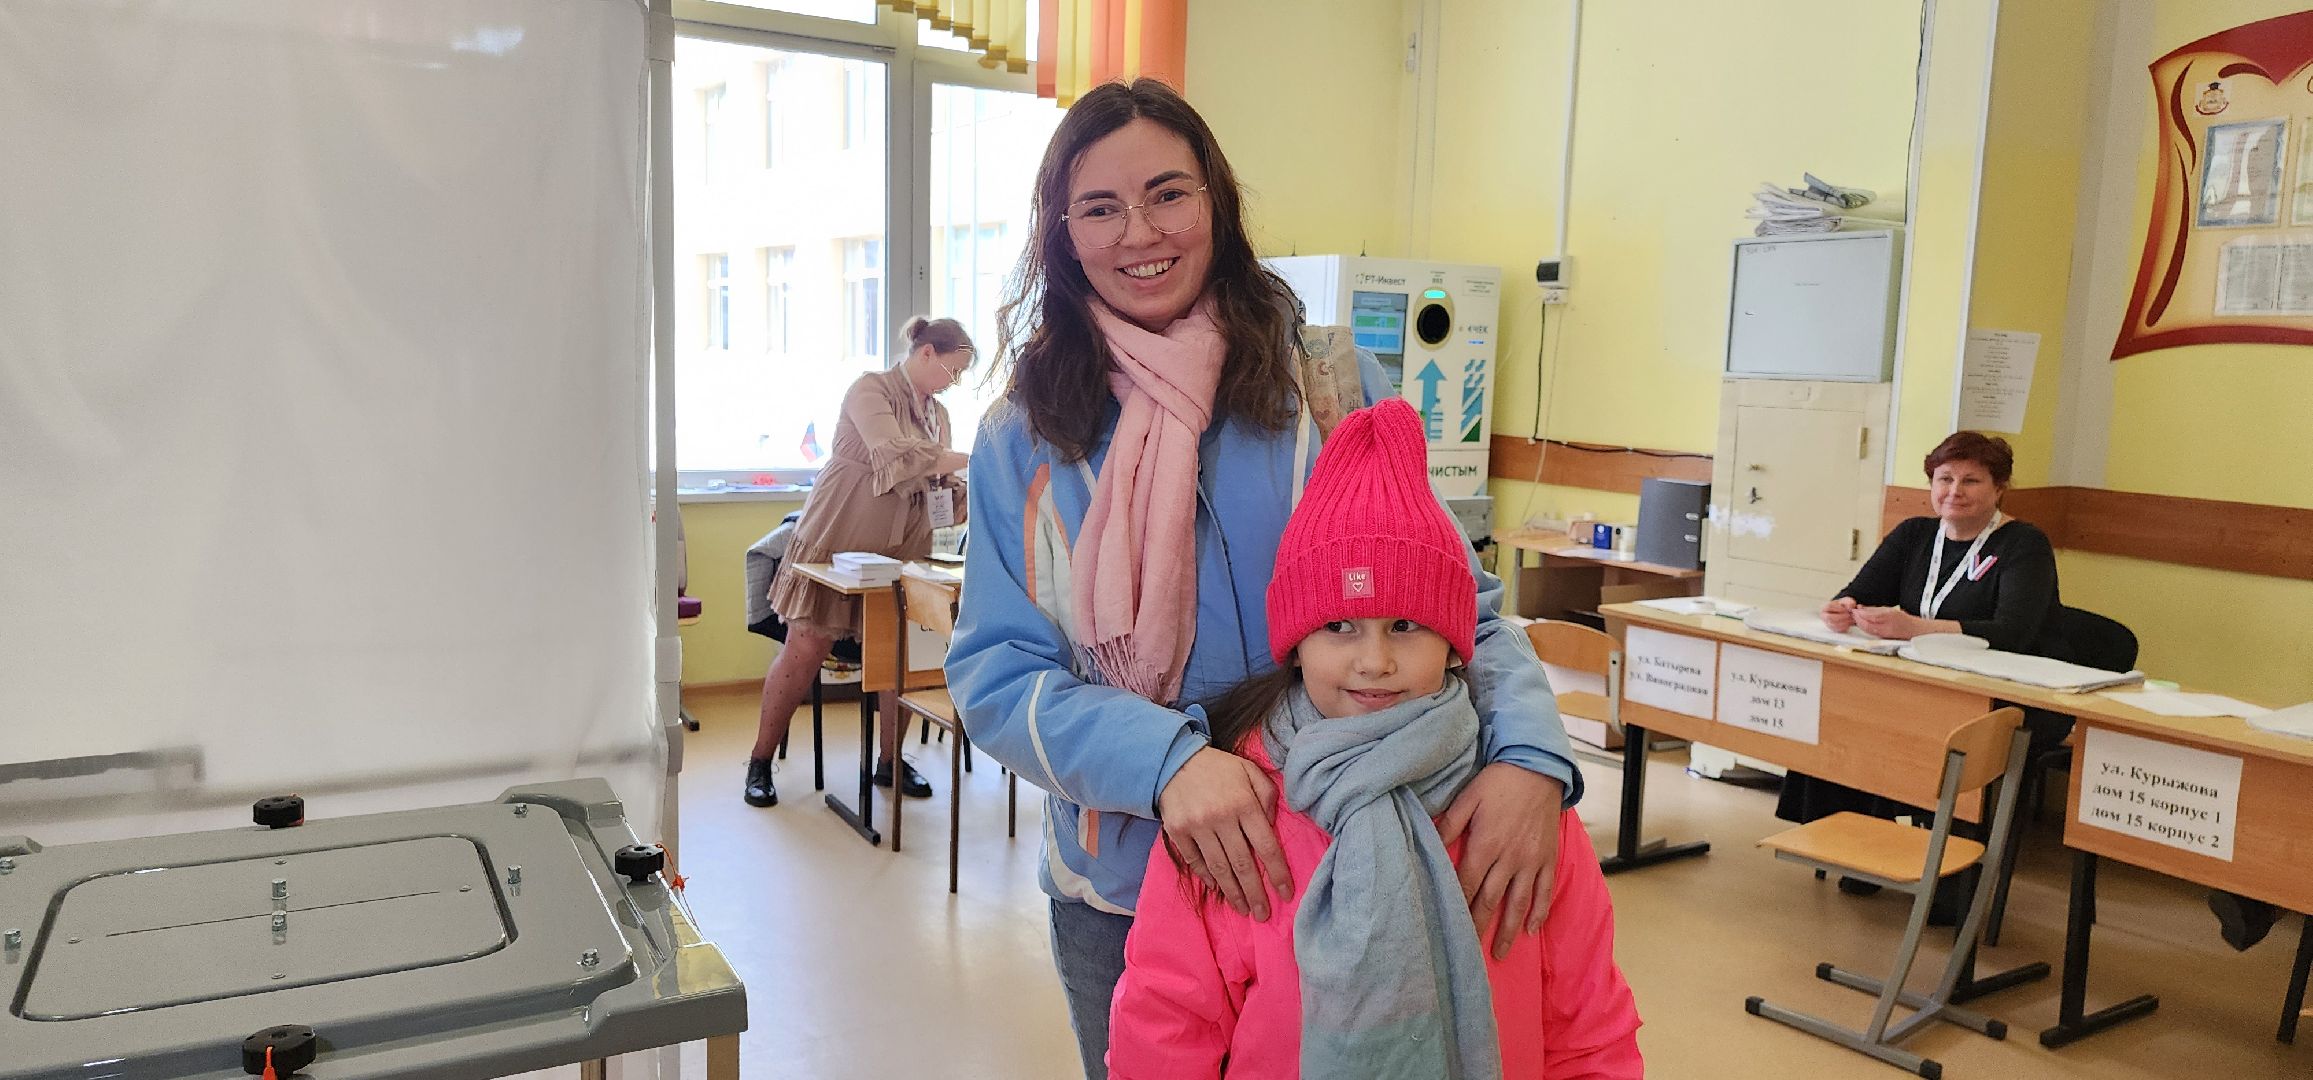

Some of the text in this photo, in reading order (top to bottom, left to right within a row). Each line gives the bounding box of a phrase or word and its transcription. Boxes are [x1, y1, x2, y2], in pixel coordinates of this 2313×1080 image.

[1428, 465, 1477, 477] ЧИСТЫМ
[2100, 762, 2219, 799] ул. Курыжова
[2092, 784, 2221, 824] дом 15 корпус 1
[2091, 807, 2220, 849] дом 15 корпус 2
